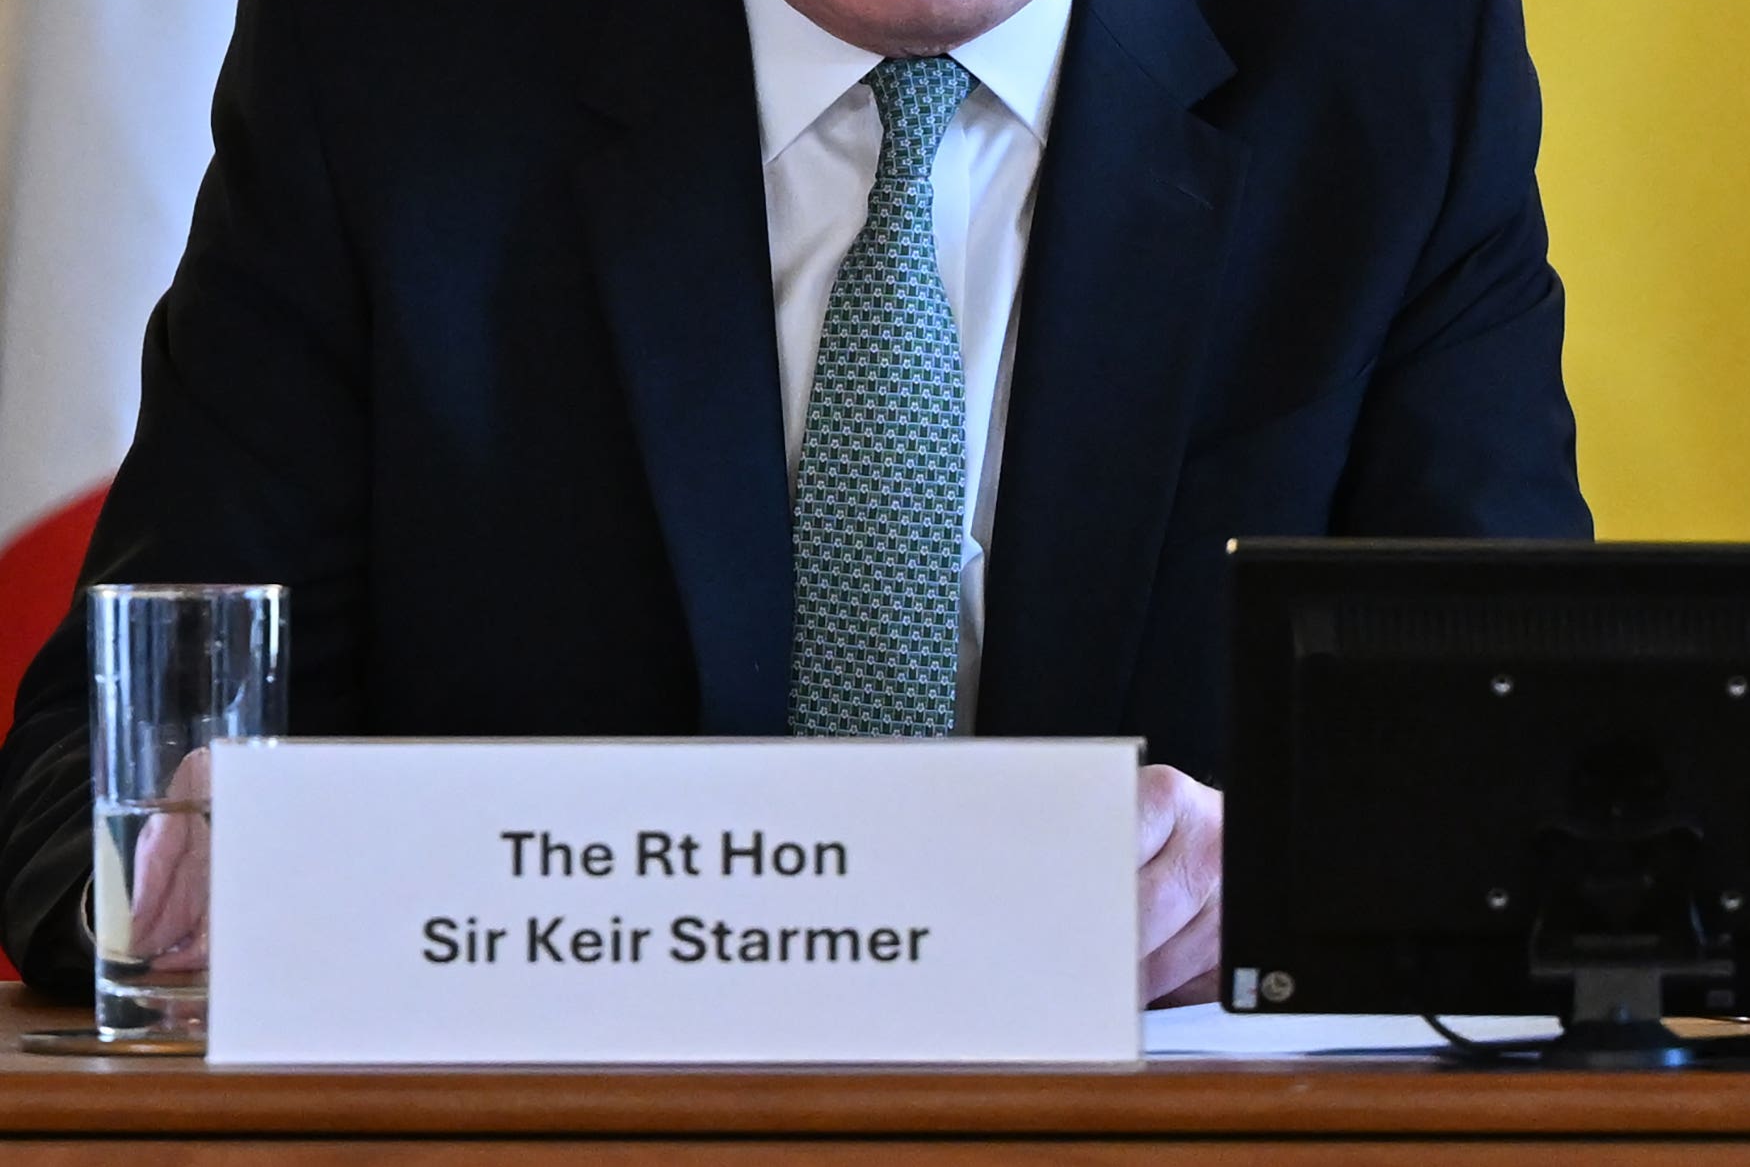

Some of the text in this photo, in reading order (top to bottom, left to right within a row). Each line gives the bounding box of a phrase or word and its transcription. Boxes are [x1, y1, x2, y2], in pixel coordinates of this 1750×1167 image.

[500, 831, 847, 877] The Rt Hon
[423, 916, 930, 964] Sir Keir Starmer
